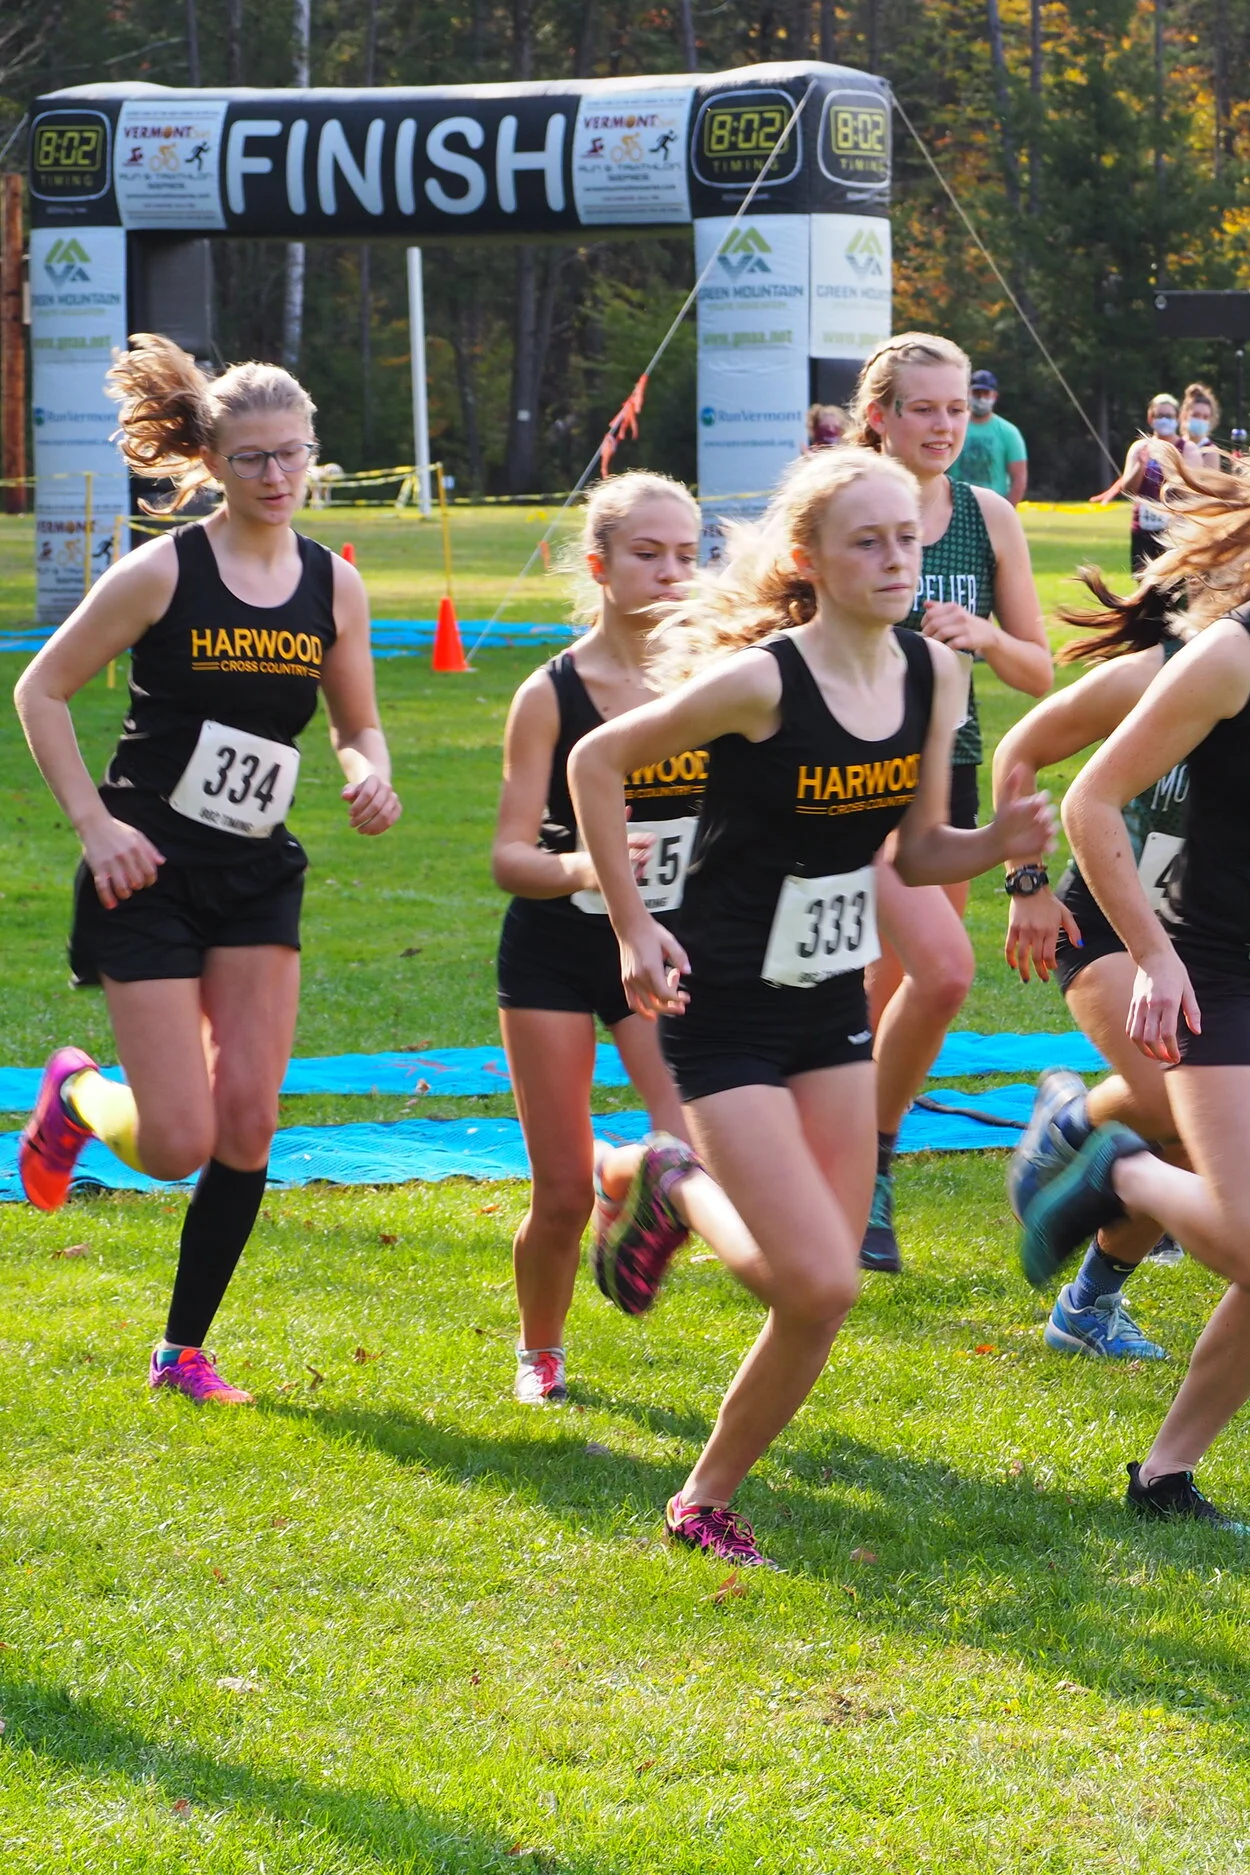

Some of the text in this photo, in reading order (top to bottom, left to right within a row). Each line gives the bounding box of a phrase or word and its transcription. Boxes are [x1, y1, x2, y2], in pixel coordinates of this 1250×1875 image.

[39, 131, 97, 166] 8:02
[709, 112, 782, 150] 8:02
[837, 112, 885, 150] 8:02
[40, 174, 94, 187] TIMING
[226, 113, 567, 216] FINISH
[712, 158, 780, 173] TIMING
[733, 284, 804, 298] MOUNTAIN
[717, 409, 803, 423] RunVermont
[912, 574, 977, 616] PELIER
[190, 628, 323, 666] HARWOOD
[220, 660, 308, 677] CROSS COUNTRY
[203, 747, 282, 813] 334
[1151, 764, 1191, 812] MO
[796, 891, 865, 958] 333
